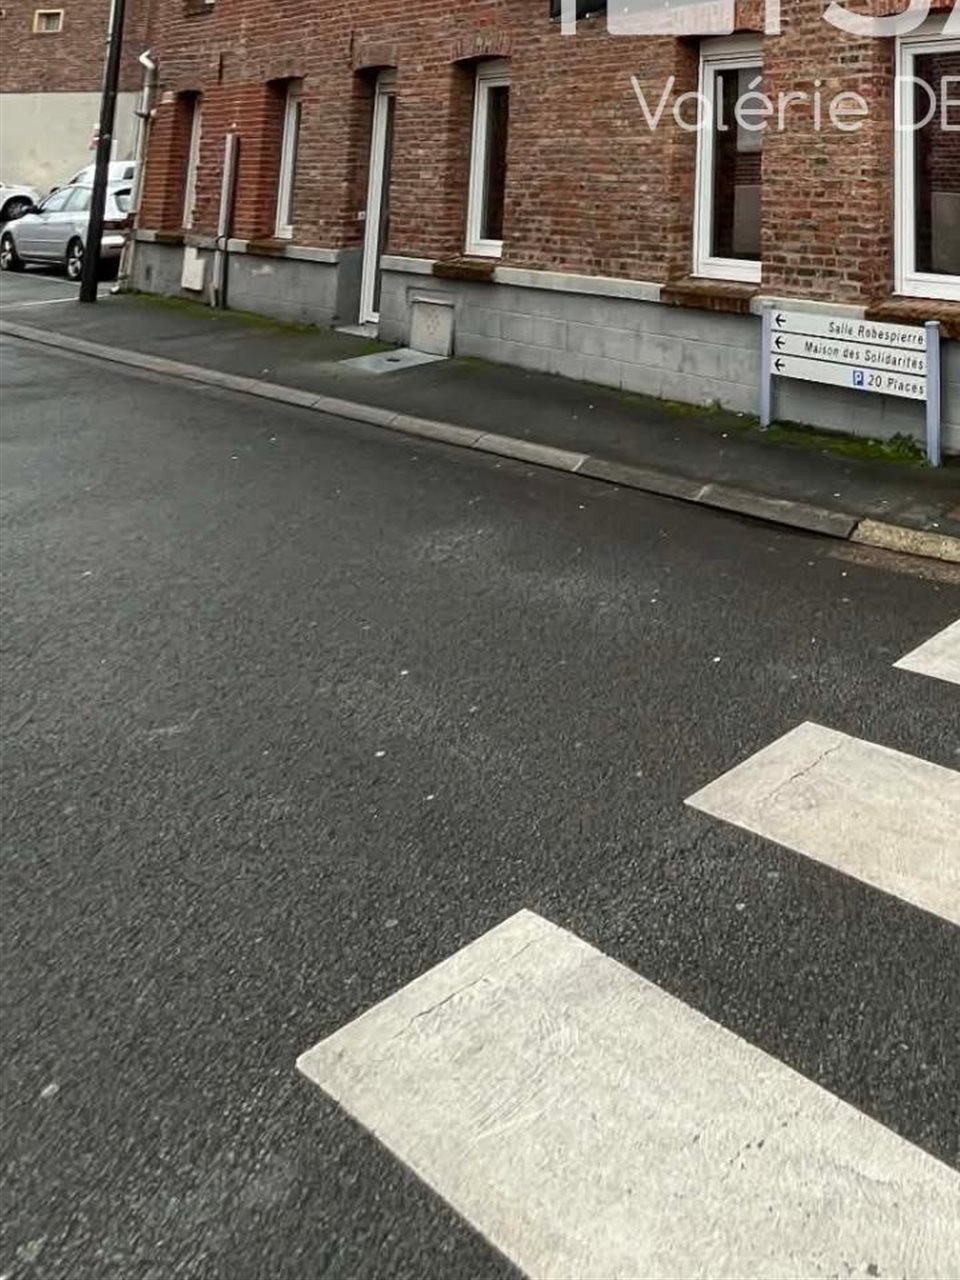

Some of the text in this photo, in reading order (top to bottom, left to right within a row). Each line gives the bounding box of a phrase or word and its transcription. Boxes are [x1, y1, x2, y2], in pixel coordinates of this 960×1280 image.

[828, 321, 924, 346] Salle Robespierre
[804, 340, 839, 356] Maison
[843, 348, 860, 361] des
[867, 374, 882, 388] 20
[886, 377, 924, 395] Places
